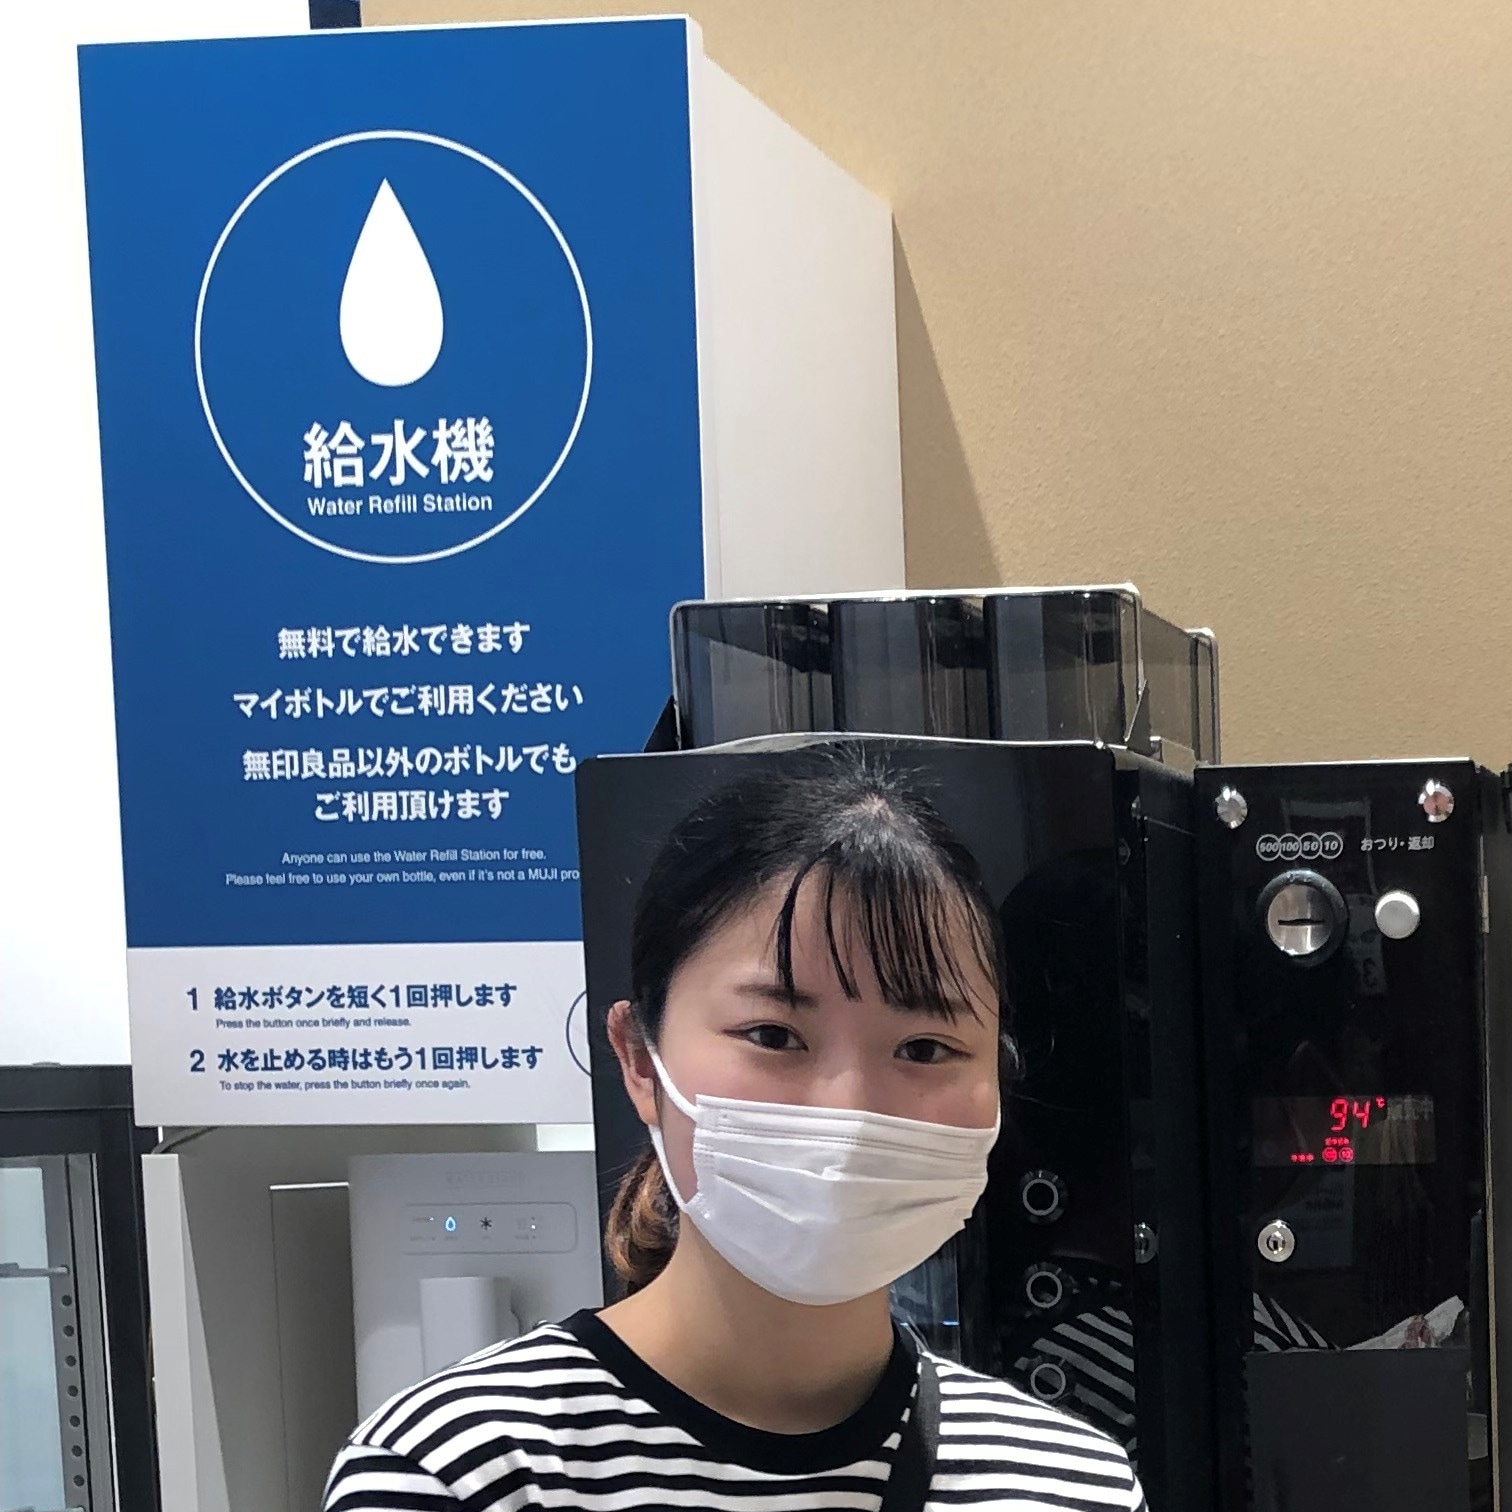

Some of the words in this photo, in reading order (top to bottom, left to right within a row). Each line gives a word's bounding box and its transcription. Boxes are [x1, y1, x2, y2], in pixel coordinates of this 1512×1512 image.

[303, 416, 495, 488] 給水機
[307, 496, 363, 516] Water
[368, 494, 417, 514] Refill
[423, 492, 493, 513] Station
[277, 621, 531, 660] 無料で給水できます
[233, 683, 584, 719] マイボトルでご利用ください
[242, 744, 577, 781] 無印良品以外のボトルでも
[314, 788, 510, 822] ご利用頂けます
[281, 851, 324, 867] Anyone
[326, 851, 348, 863] can
[350, 852, 371, 863] use
[373, 850, 392, 863] the
[393, 849, 427, 862] Water
[430, 848, 458, 861] Refill
[461, 847, 500, 861] Station
[503, 847, 519, 860] for
[521, 847, 547, 860] free.
[1324, 840, 1338, 850] 10
[225, 873, 264, 886] Please
[265, 872, 286, 885] feel
[288, 871, 310, 884] free
[312, 872, 324, 884] to
[326, 873, 347, 884] use
[349, 872, 374, 886] your
[376, 872, 400, 883] own
[402, 870, 437, 883] bottle,
[439, 871, 466, 882] even
[468, 868, 476, 881] if
[478, 868, 495, 881] it's
[497, 868, 516, 880] not
[528, 867, 558, 880] MUJI
[186, 986, 200, 1010] 1
[214, 984, 518, 1010] 給水ボタンを短く1回押します
[215, 1018, 244, 1029] Press
[245, 1018, 262, 1028] the
[263, 1018, 294, 1028] button
[295, 1019, 320, 1028] once
[322, 1017, 351, 1029] briefly
[353, 1018, 372, 1027] and
[373, 1018, 411, 1027] release.
[189, 1050, 205, 1072] 2
[217, 1046, 544, 1074] 水を止める時はもう1回押します
[220, 1080, 232, 1091] To
[234, 1080, 254, 1091] stop
[256, 1080, 272, 1090] the
[274, 1080, 302, 1091] water,
[304, 1081, 331, 1091] press
[333, 1079, 349, 1089] the
[351, 1079, 382, 1089] button
[384, 1078, 412, 1090] briefly
[415, 1080, 440, 1088] once
[442, 1079, 471, 1090] again.
